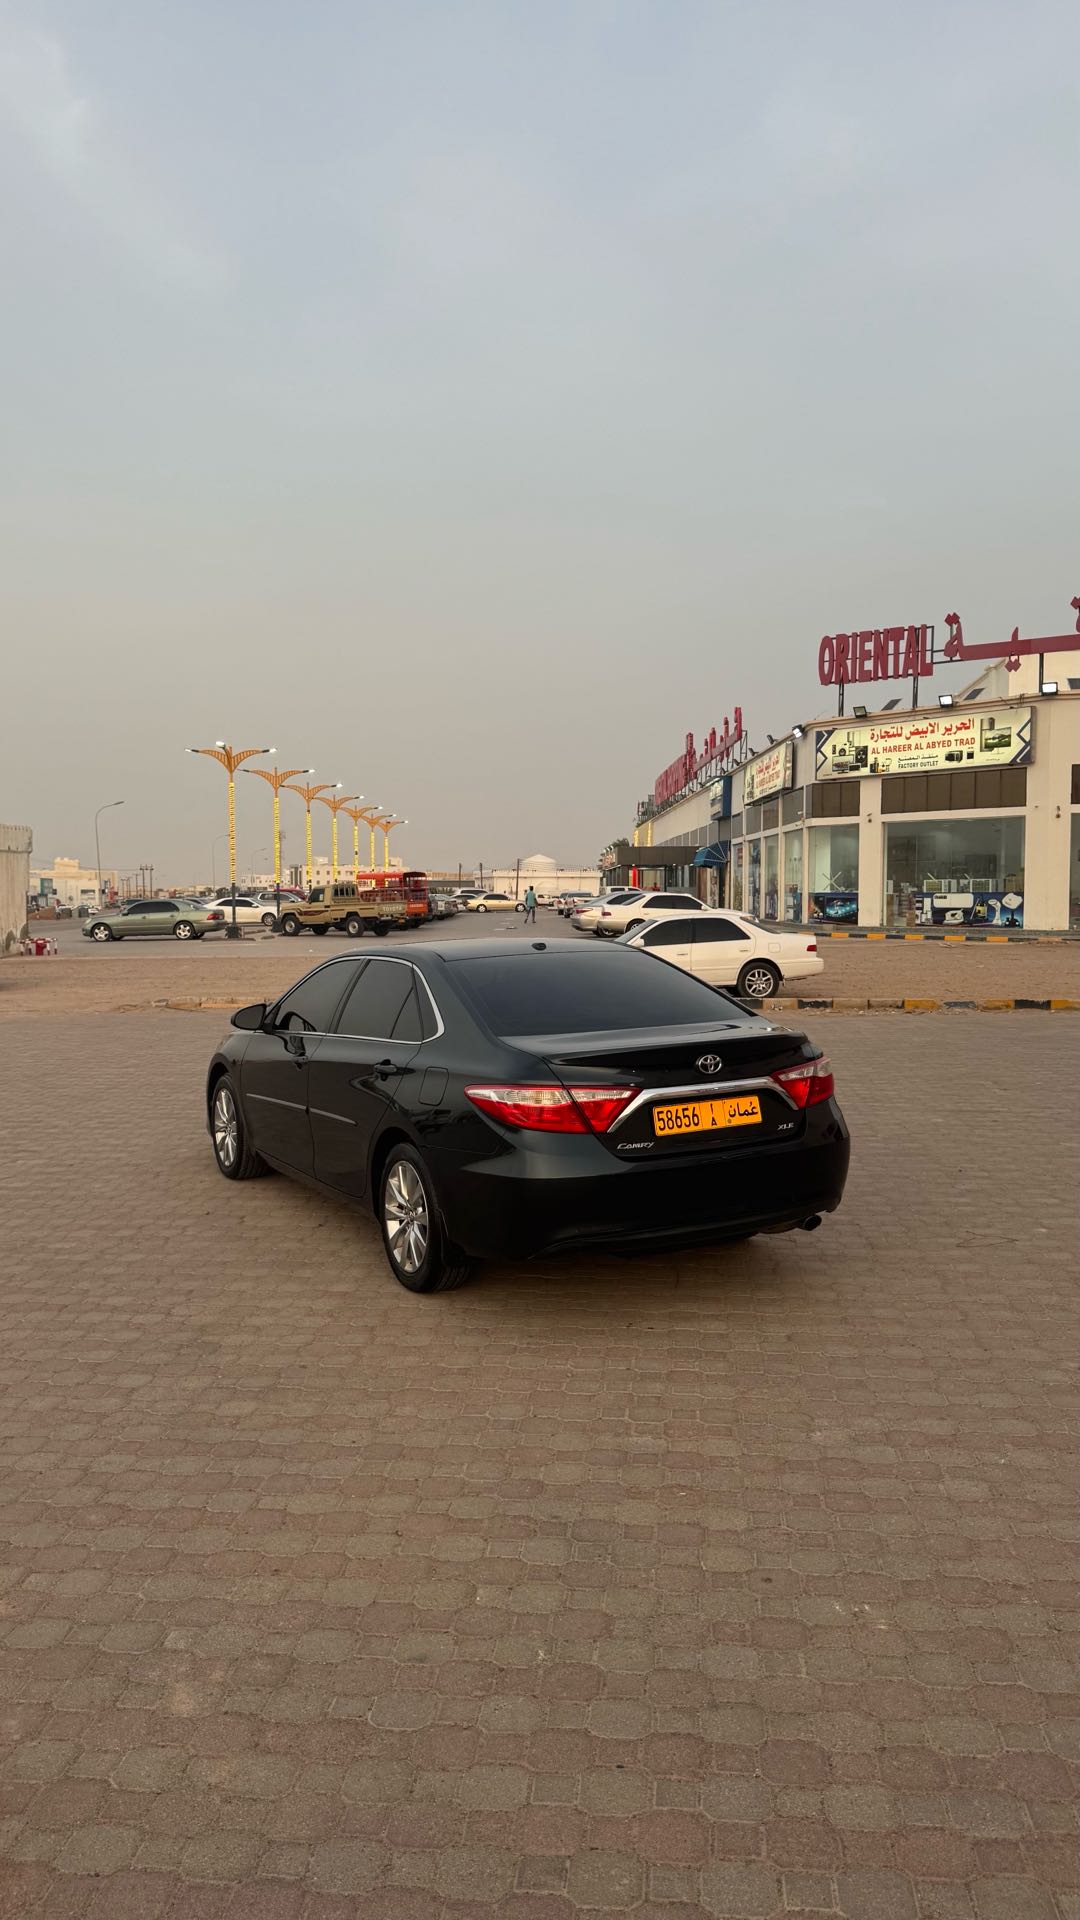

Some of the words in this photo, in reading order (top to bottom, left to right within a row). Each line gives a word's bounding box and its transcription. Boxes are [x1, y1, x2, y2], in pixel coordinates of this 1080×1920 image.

[818, 624, 933, 685] ORIENTAL
[870, 726, 903, 743] للتجارة
[941, 718, 975, 735] الحرير
[871, 747, 880, 755] AL
[882, 744, 912, 753] HAREER
[914, 743, 925, 751] AL
[926, 740, 952, 749] ABYED
[954, 737, 976, 746] TRAD
[657, 1106, 700, 1131] 58656
[777, 1119, 795, 1131] XLE
